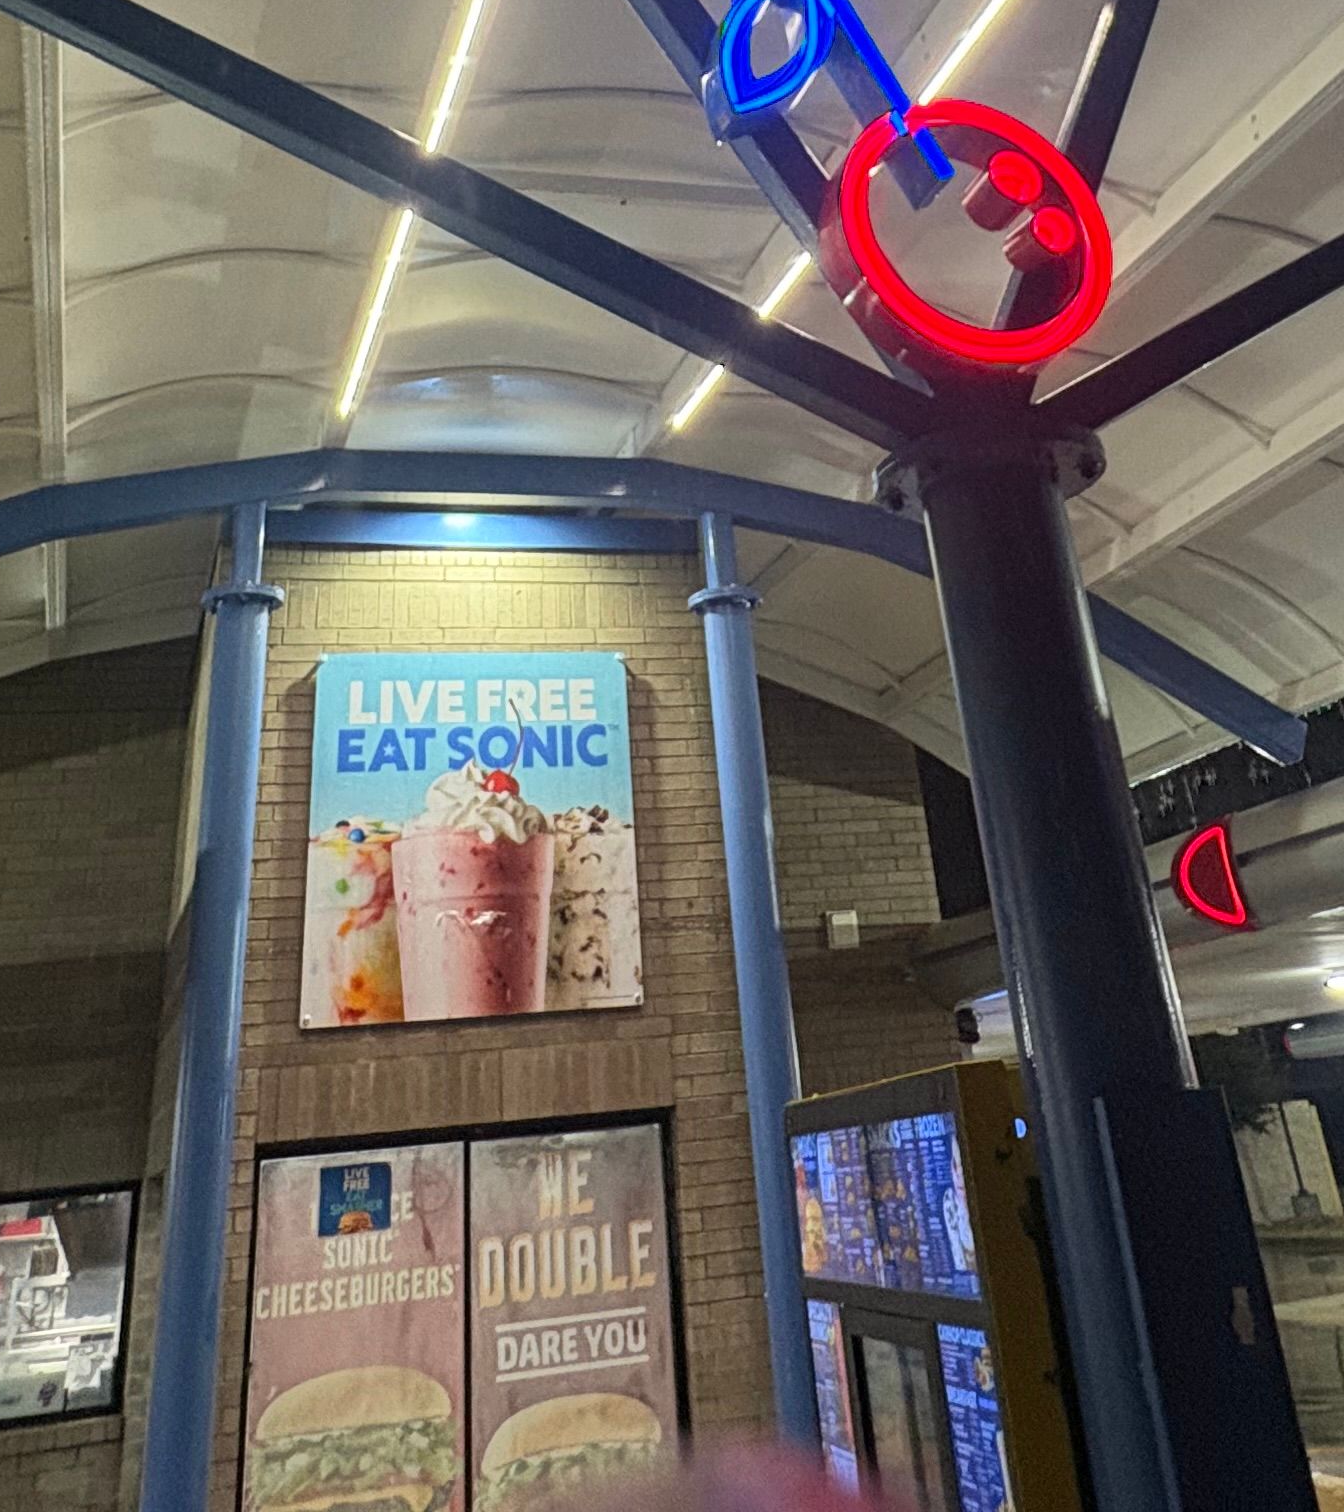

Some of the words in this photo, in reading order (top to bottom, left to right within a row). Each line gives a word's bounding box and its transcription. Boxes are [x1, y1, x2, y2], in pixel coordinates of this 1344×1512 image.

[348, 679, 466, 725] LIVE
[477, 678, 597, 723] FREE
[337, 727, 436, 773] EAT
[343, 1167, 370, 1179] LIVE
[343, 1178, 370, 1192] FREE
[538, 1148, 594, 1221] WE
[322, 1233, 394, 1270] SONIC
[478, 1219, 657, 1309] DOUBLE
[496, 1327, 579, 1372] DARE
[584, 1318, 647, 1358] YOU
